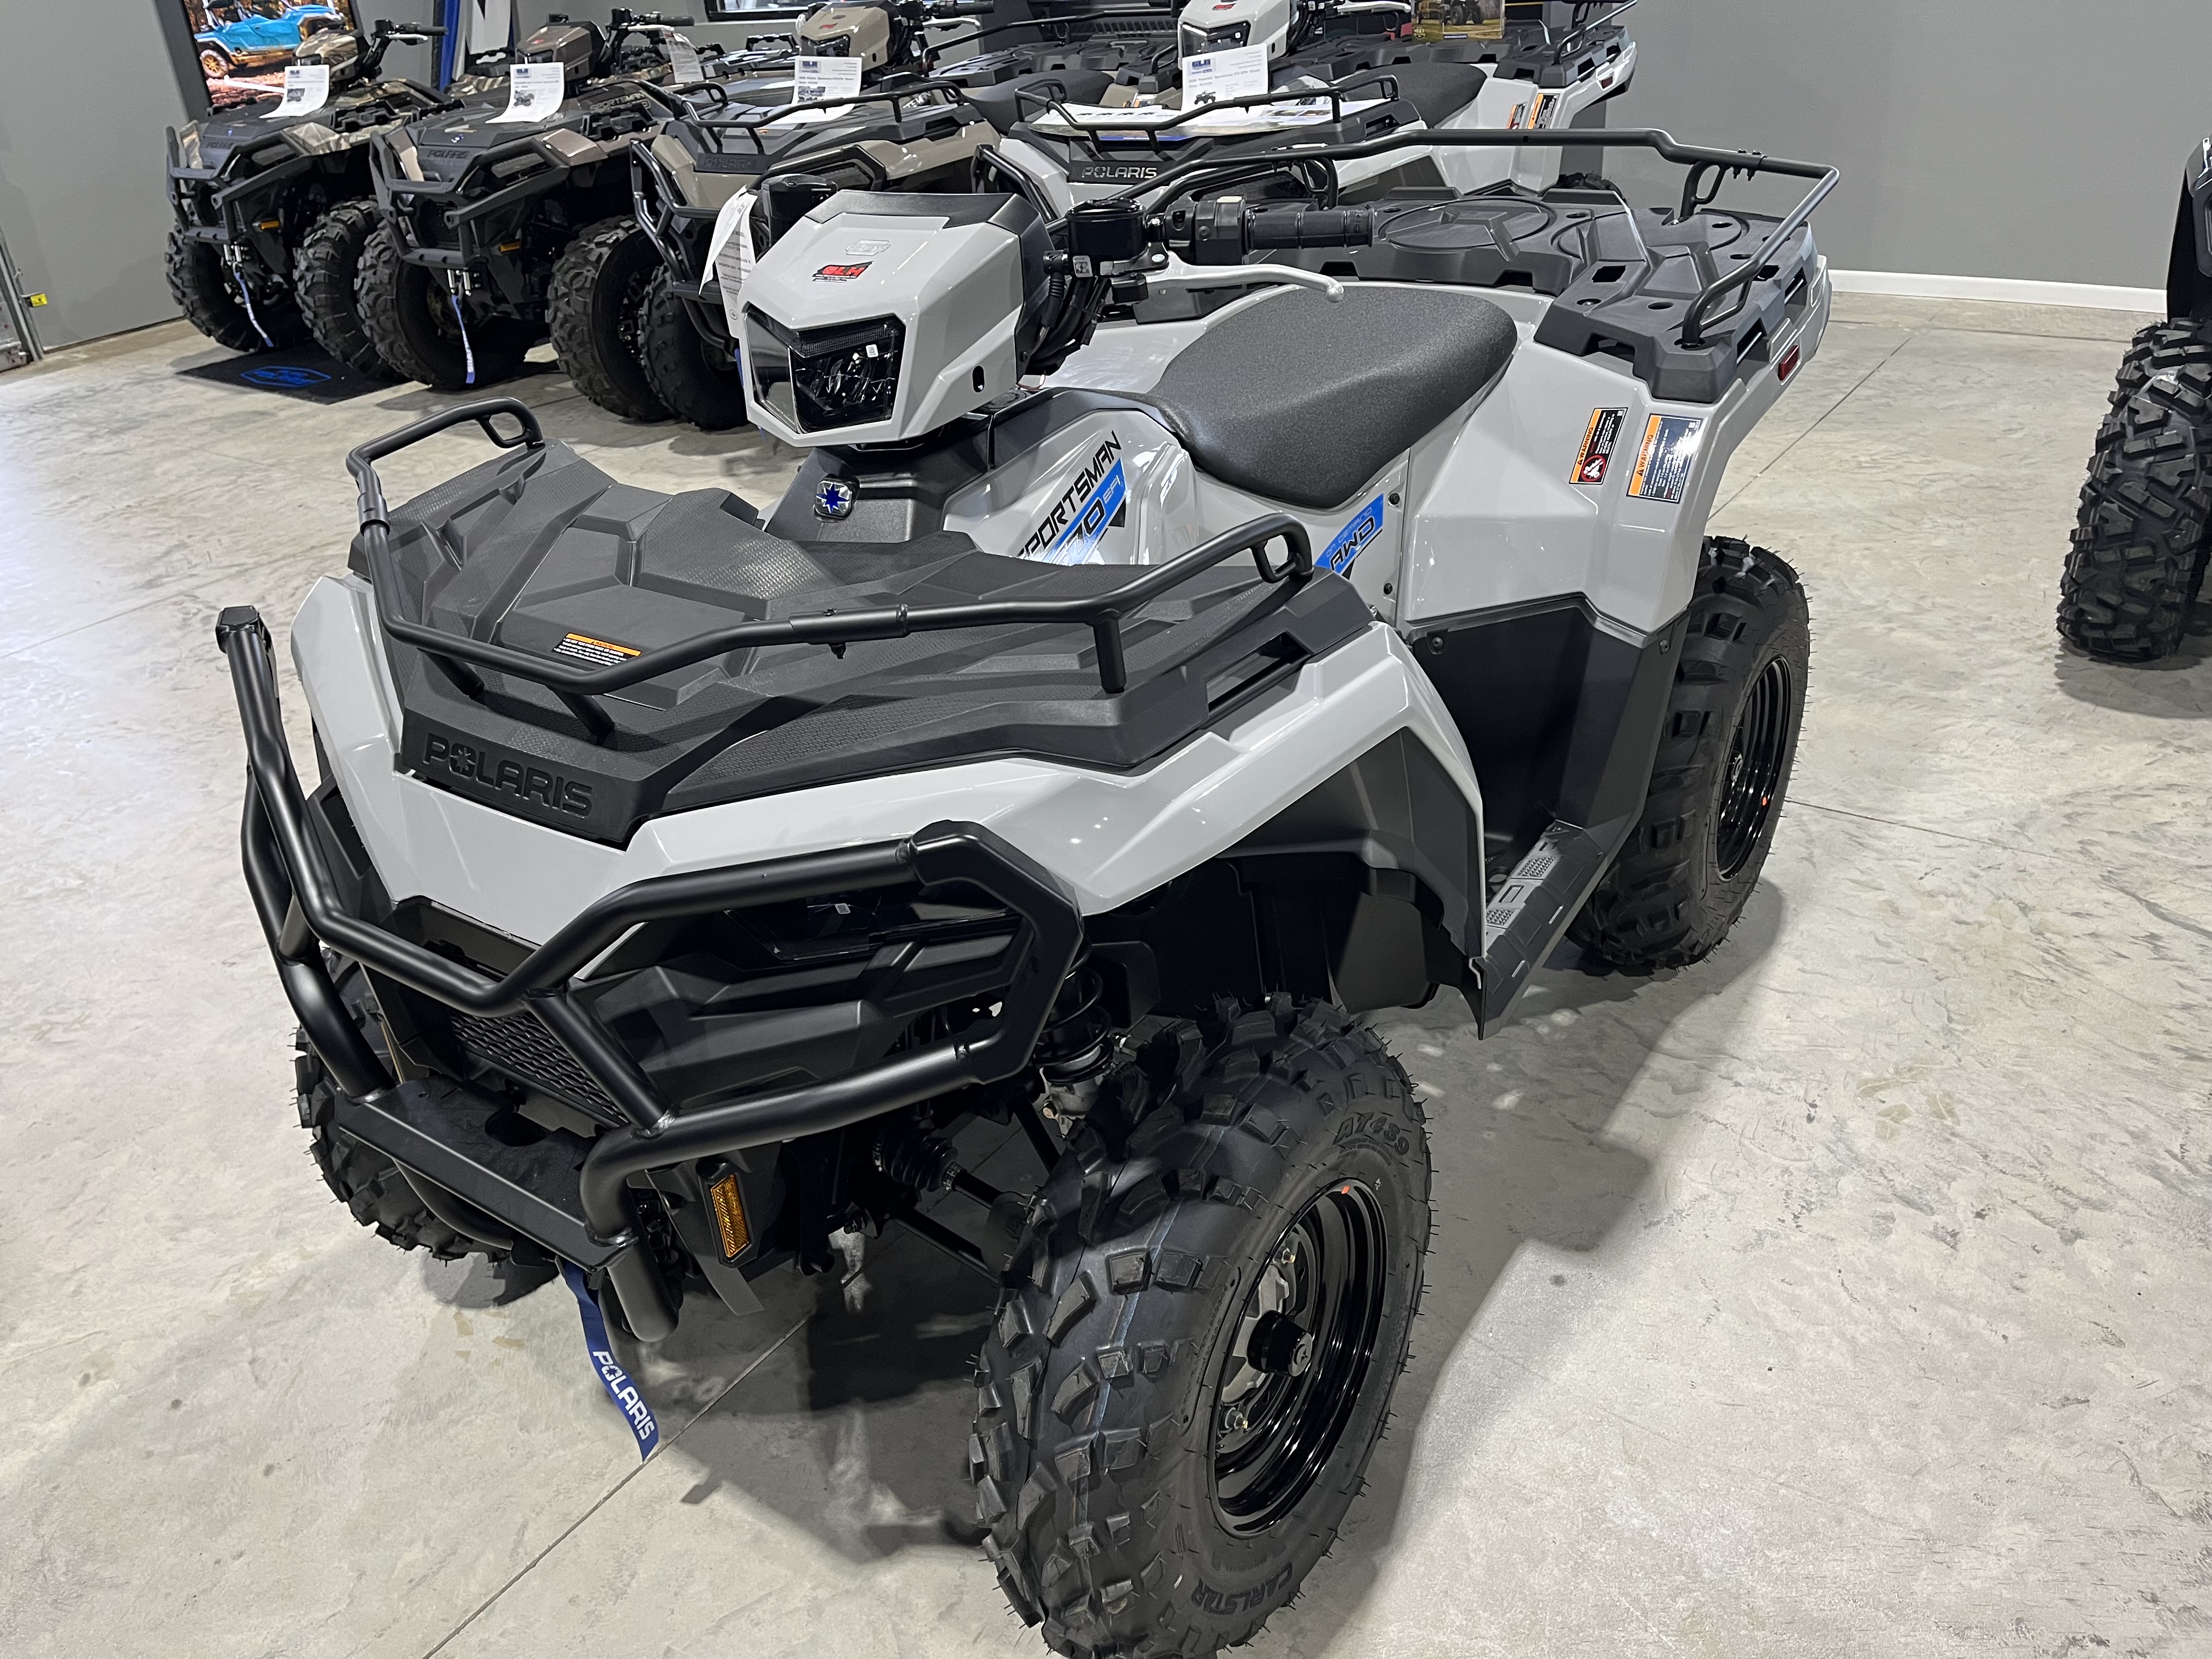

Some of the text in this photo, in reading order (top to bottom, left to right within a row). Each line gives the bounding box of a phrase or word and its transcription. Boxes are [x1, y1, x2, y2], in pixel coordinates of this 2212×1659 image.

[1081, 166, 1157, 178] POLARIS
[822, 266, 865, 276] GLH
[1579, 427, 1594, 459] WARNING
[1639, 435, 1654, 468] WARNING
[1016, 431, 1121, 557] PORTSMAN
[1103, 475, 1121, 504] EFI
[1330, 516, 1375, 571] AWD
[422, 733, 593, 819] POLARIS
[1333, 1112, 1409, 1155] AT489
[592, 1351, 655, 1440] POLARIS
[1191, 1562, 1293, 1615] CARLSTAR
